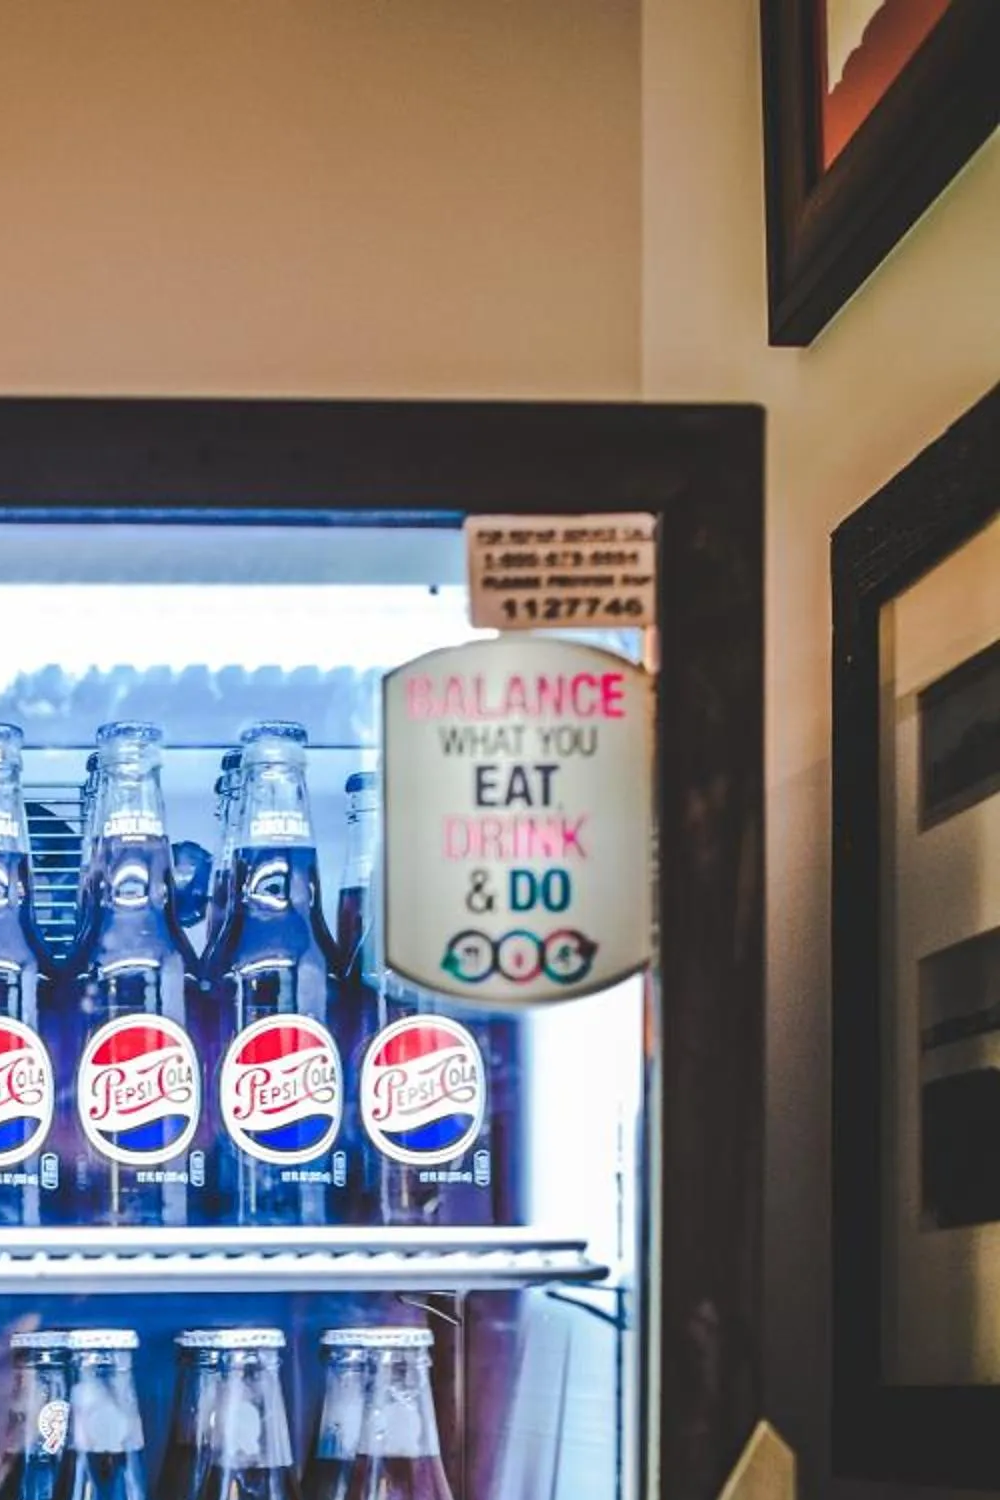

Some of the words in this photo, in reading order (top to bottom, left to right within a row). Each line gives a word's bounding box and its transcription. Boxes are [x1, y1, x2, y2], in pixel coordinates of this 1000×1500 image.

[406, 672, 627, 719] BALANCE
[439, 725, 527, 757] WHAT
[537, 726, 599, 757] YOU
[442, 814, 588, 860] DRINK
[465, 868, 495, 914] &
[508, 868, 574, 913] DO
